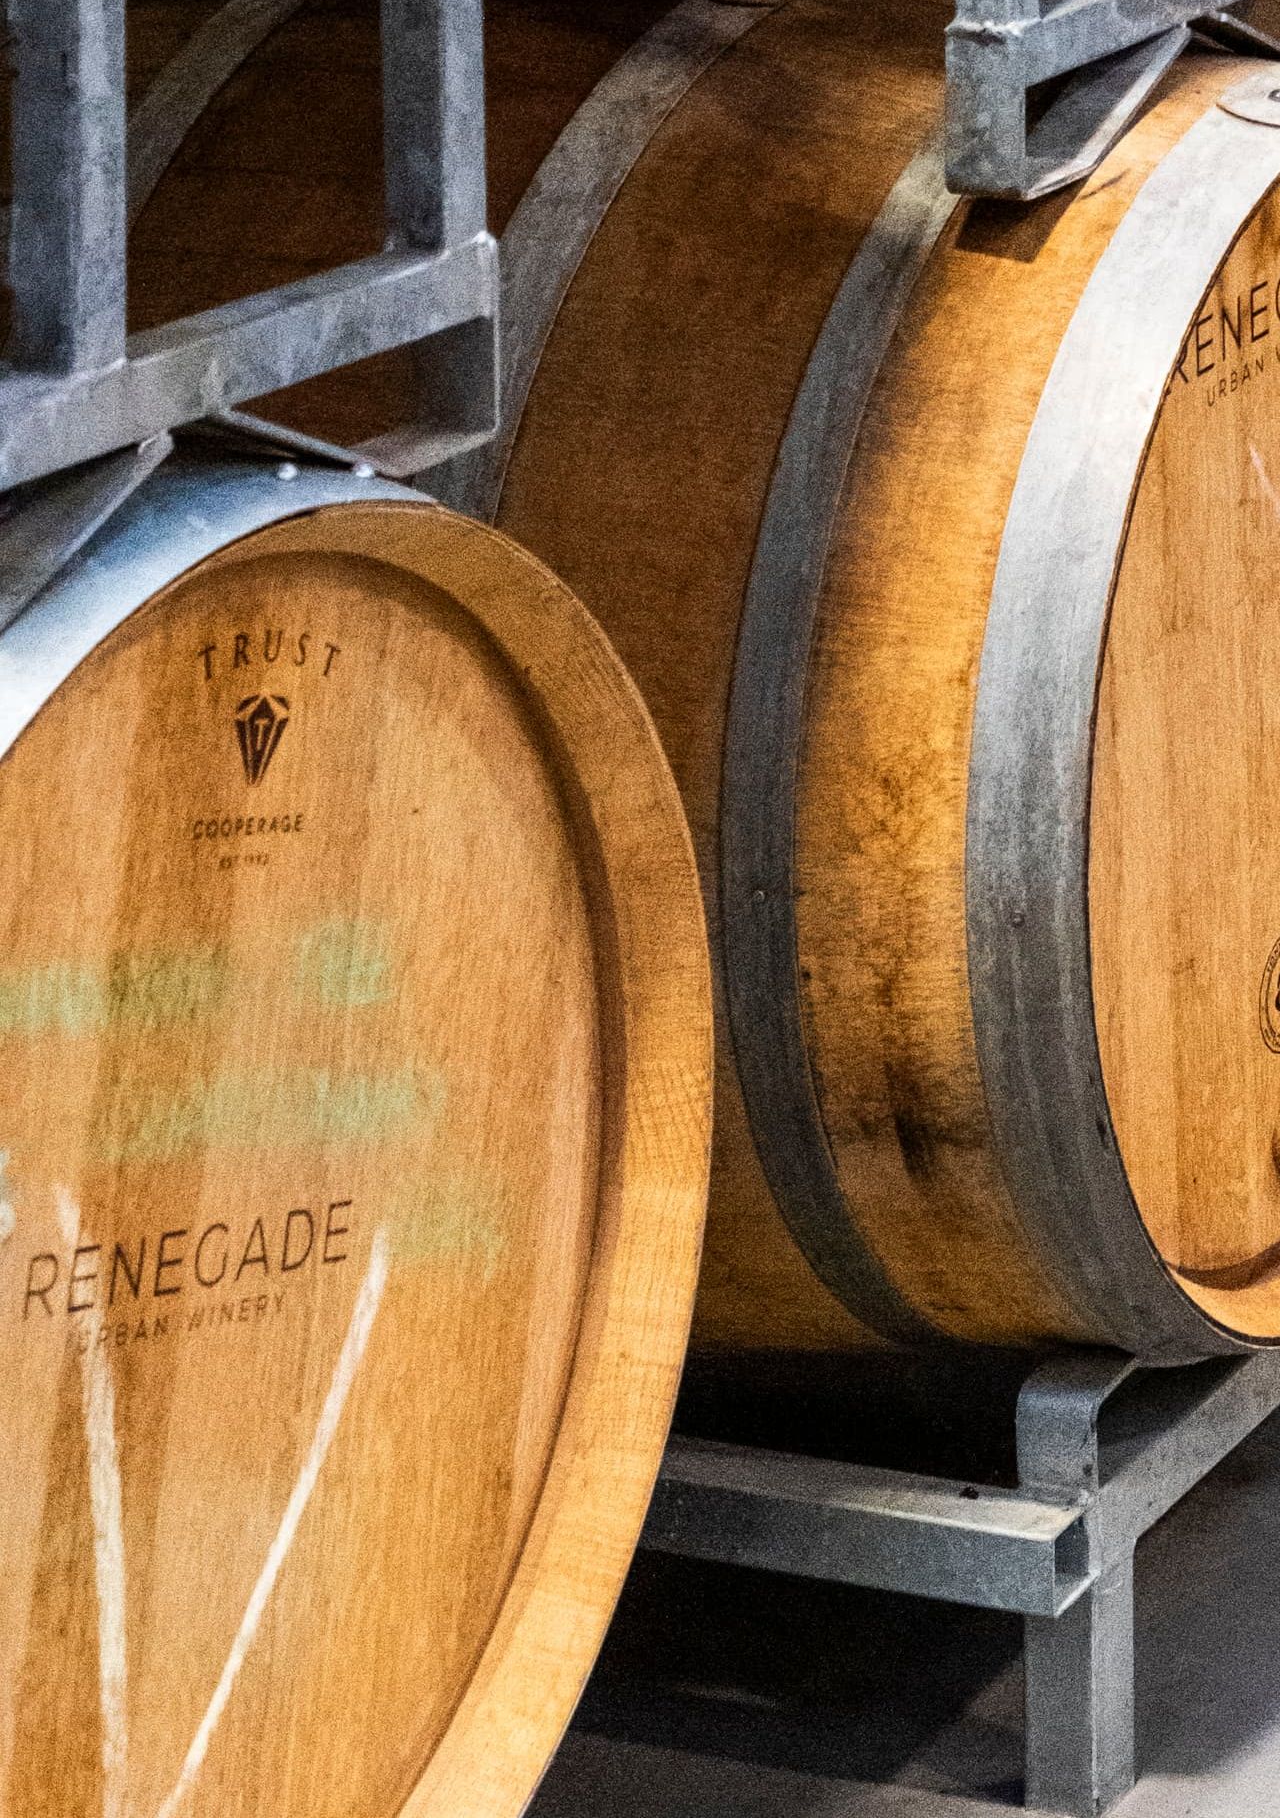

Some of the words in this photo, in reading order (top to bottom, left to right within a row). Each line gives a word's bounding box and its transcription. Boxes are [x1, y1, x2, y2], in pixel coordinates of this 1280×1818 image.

[1206, 358, 1265, 408] URBAN
[198, 629, 341, 681] TRUST
[192, 814, 304, 841] COOPERAGE
[21, 1200, 353, 1322] RENEGADE
